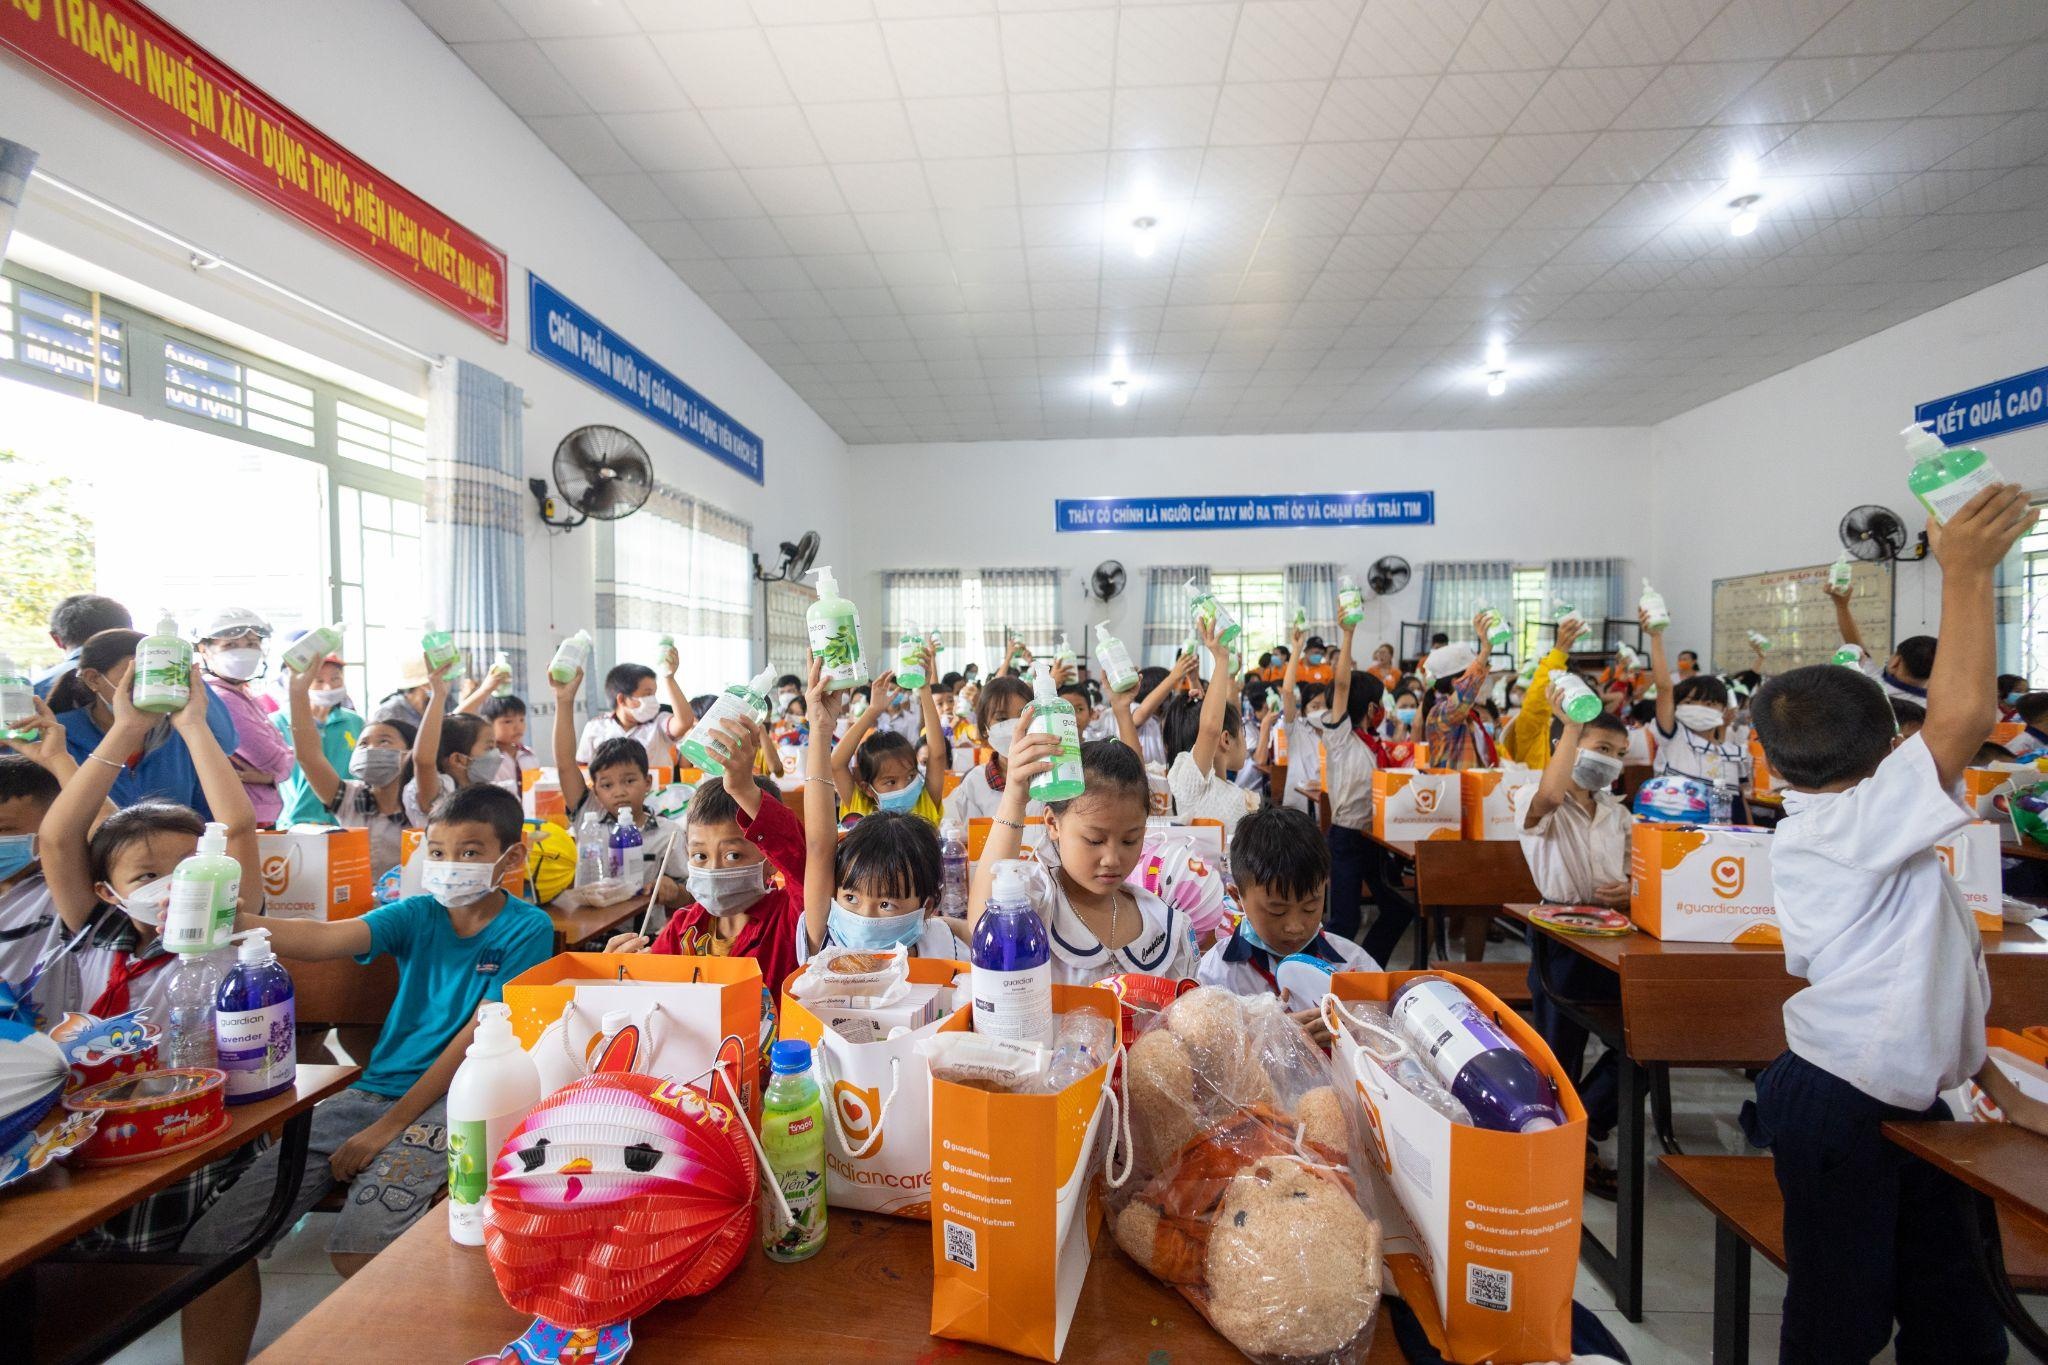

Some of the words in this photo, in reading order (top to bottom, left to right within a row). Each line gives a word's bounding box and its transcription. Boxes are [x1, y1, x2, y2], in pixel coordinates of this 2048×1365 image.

[144, 39, 216, 137] NHIỆM
[218, 89, 257, 159] XÂY
[260, 118, 308, 192] DỰNG
[310, 152, 351, 225] THỰC
[353, 181, 386, 246] HIỆN
[387, 204, 420, 273] NGHỊ
[420, 227, 458, 285] QUYẾT
[1936, 401, 1967, 436] KẾT
[1969, 388, 2003, 428] QUẢ
[2006, 386, 2043, 418] CAO
[1112, 504, 1144, 524] CHÍNH
[1145, 503, 1159, 523] LÀ
[1217, 505, 1237, 521] TAY
[1256, 505, 1271, 521] RA
[1402, 501, 1422, 518] TIM
[1676, 901, 1777, 916] #guardiancares
[1003, 977, 1034, 988] guardian
[221, 1014, 264, 1027] guardian
[221, 1033, 263, 1043] lavender
[950, 1143, 990, 1160] guardianvn
[827, 1152, 931, 1189] ardiancare
[950, 1165, 1012, 1183] guardianvietnam
[950, 1186, 1012, 1205] guardianvietnam
[950, 1206, 981, 1223] Guardian
[982, 1217, 1015, 1227] Vietnam
[1475, 1222, 1519, 1236] Guardian
[1520, 1224, 1555, 1237] Flagship
[1555, 1217, 1573, 1230] Store
[1475, 1242, 1550, 1257] guardian.com.vn
